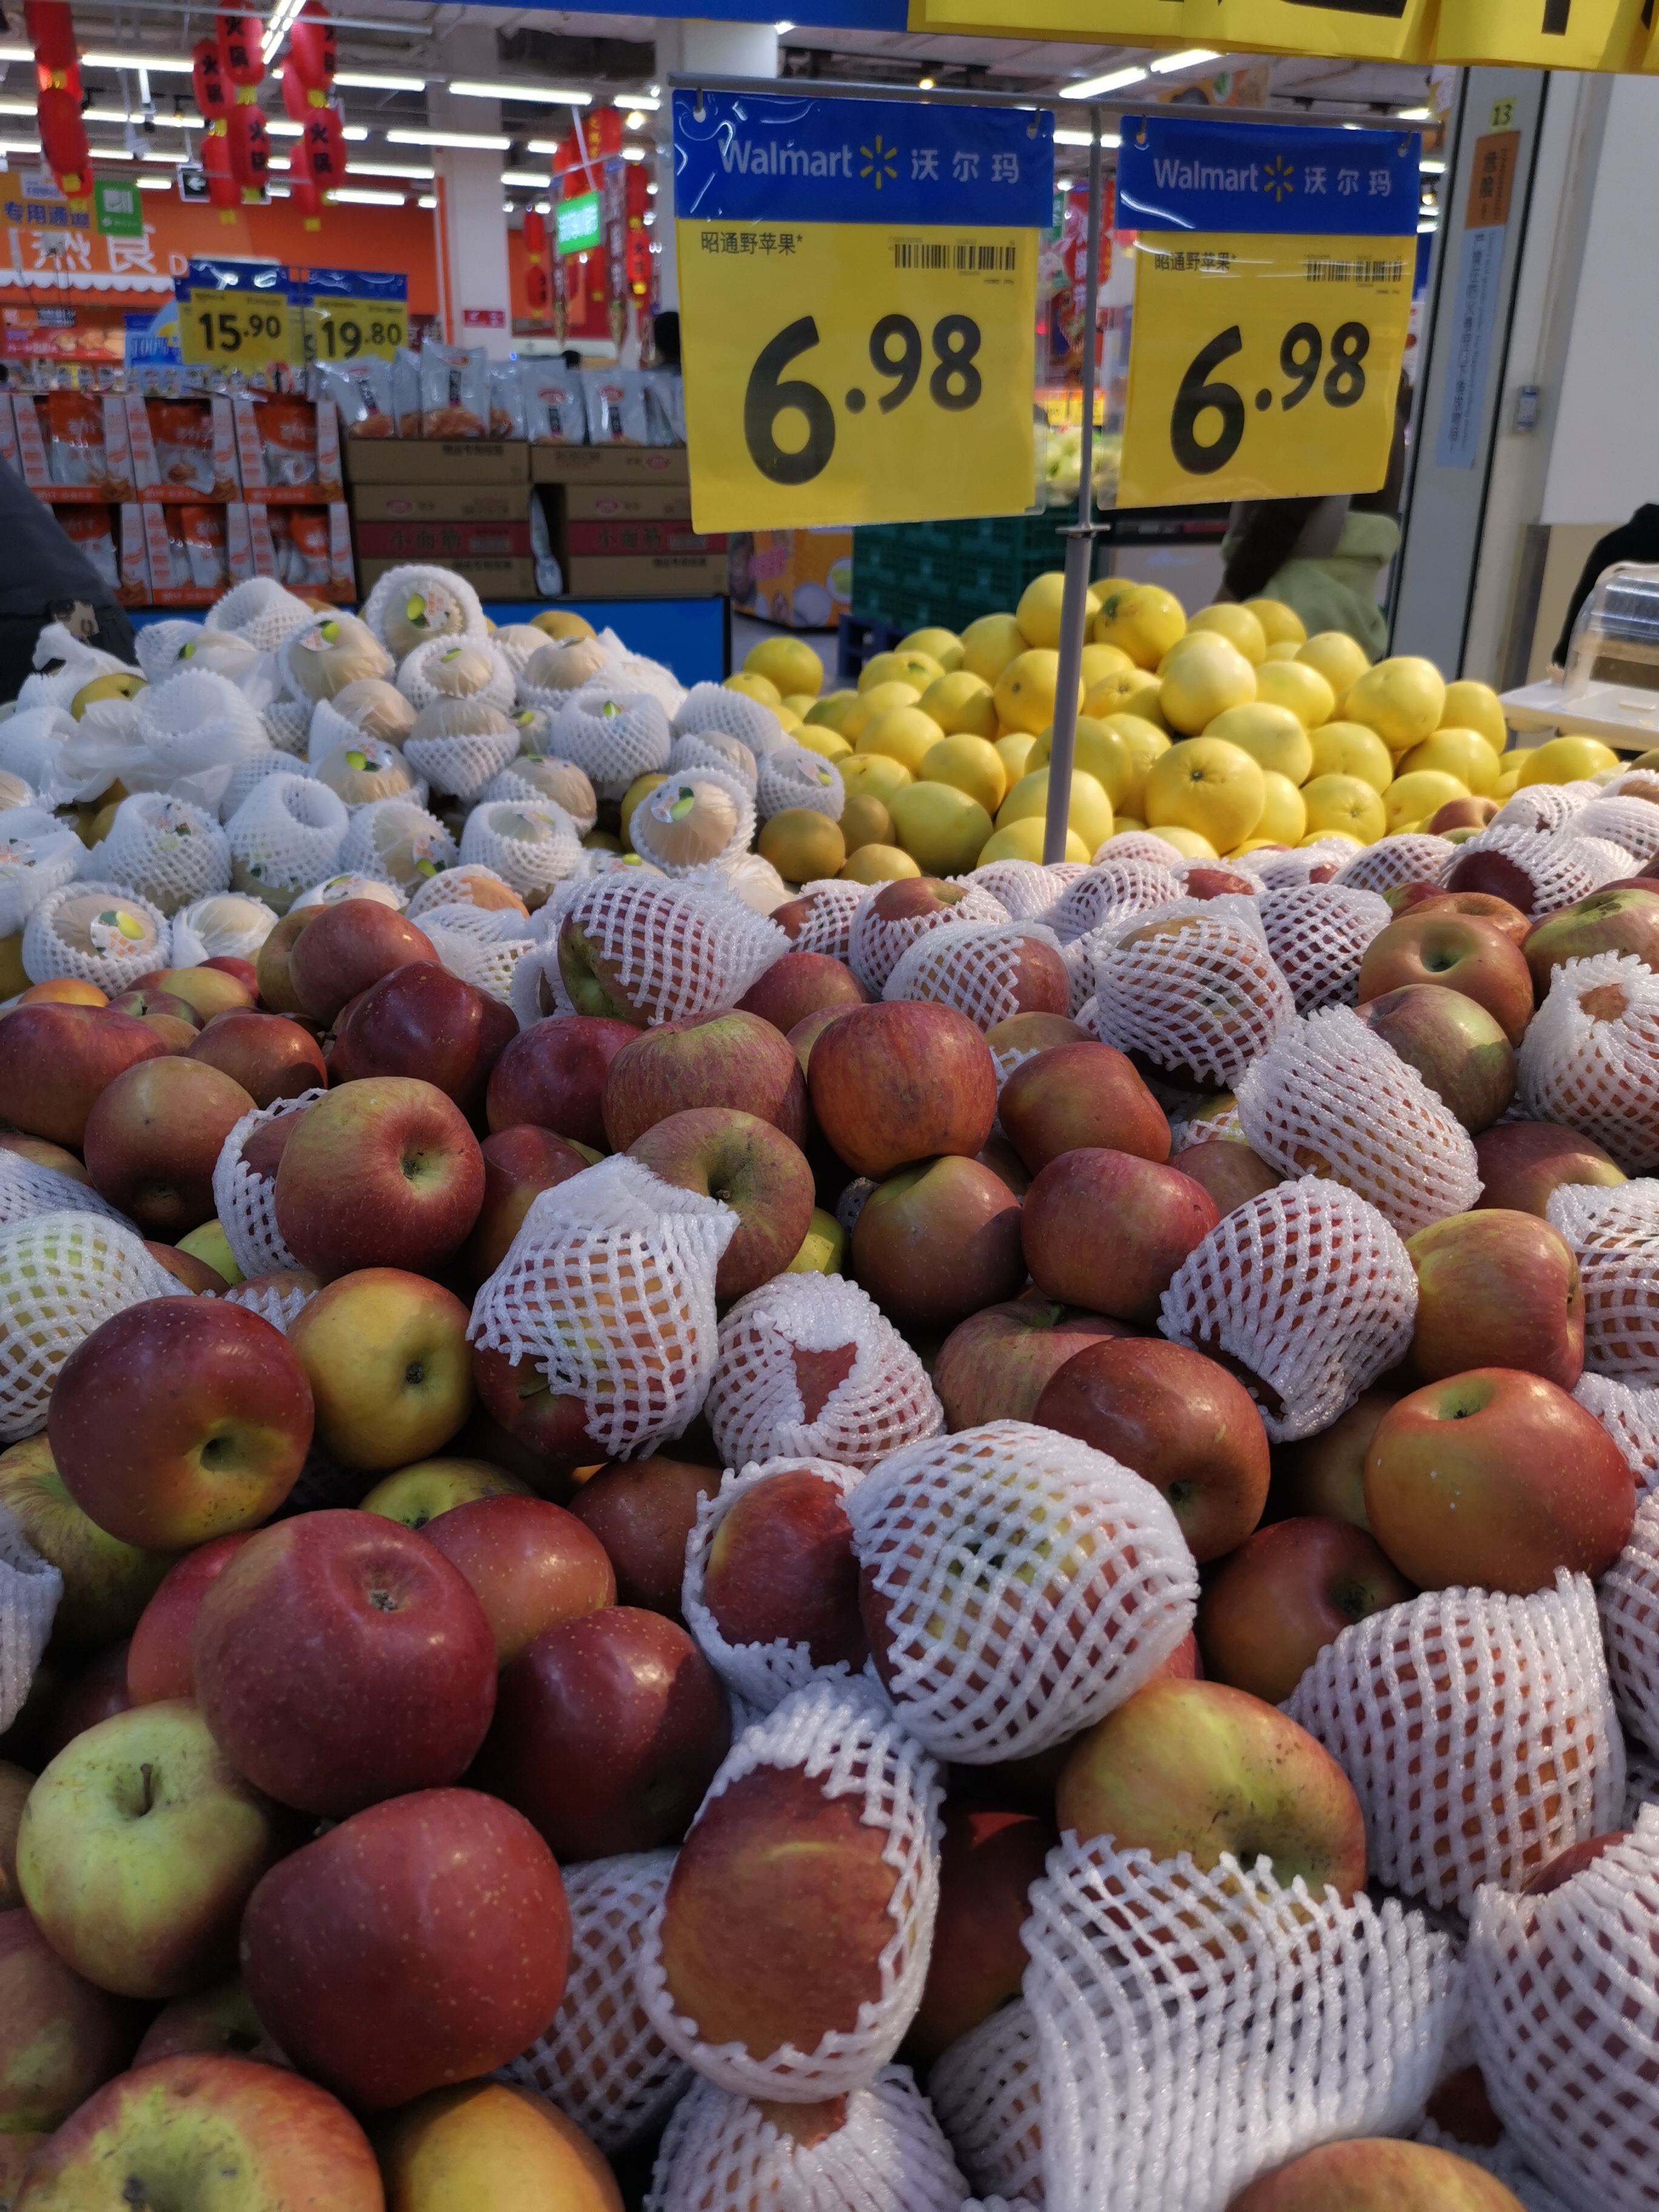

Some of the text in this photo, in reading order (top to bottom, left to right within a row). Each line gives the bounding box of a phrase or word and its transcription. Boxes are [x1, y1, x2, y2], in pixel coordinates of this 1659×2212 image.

[718, 138, 853, 177] Walmart
[911, 149, 1019, 184] 沃尔玛
[1154, 159, 1259, 192] Walmart
[1304, 167, 1392, 197] 沃尔玛
[199, 313, 281, 352] 15.90
[322, 321, 403, 358] 19.80
[744, 313, 982, 486] 6.98
[1170, 321, 1370, 475] 6.98
